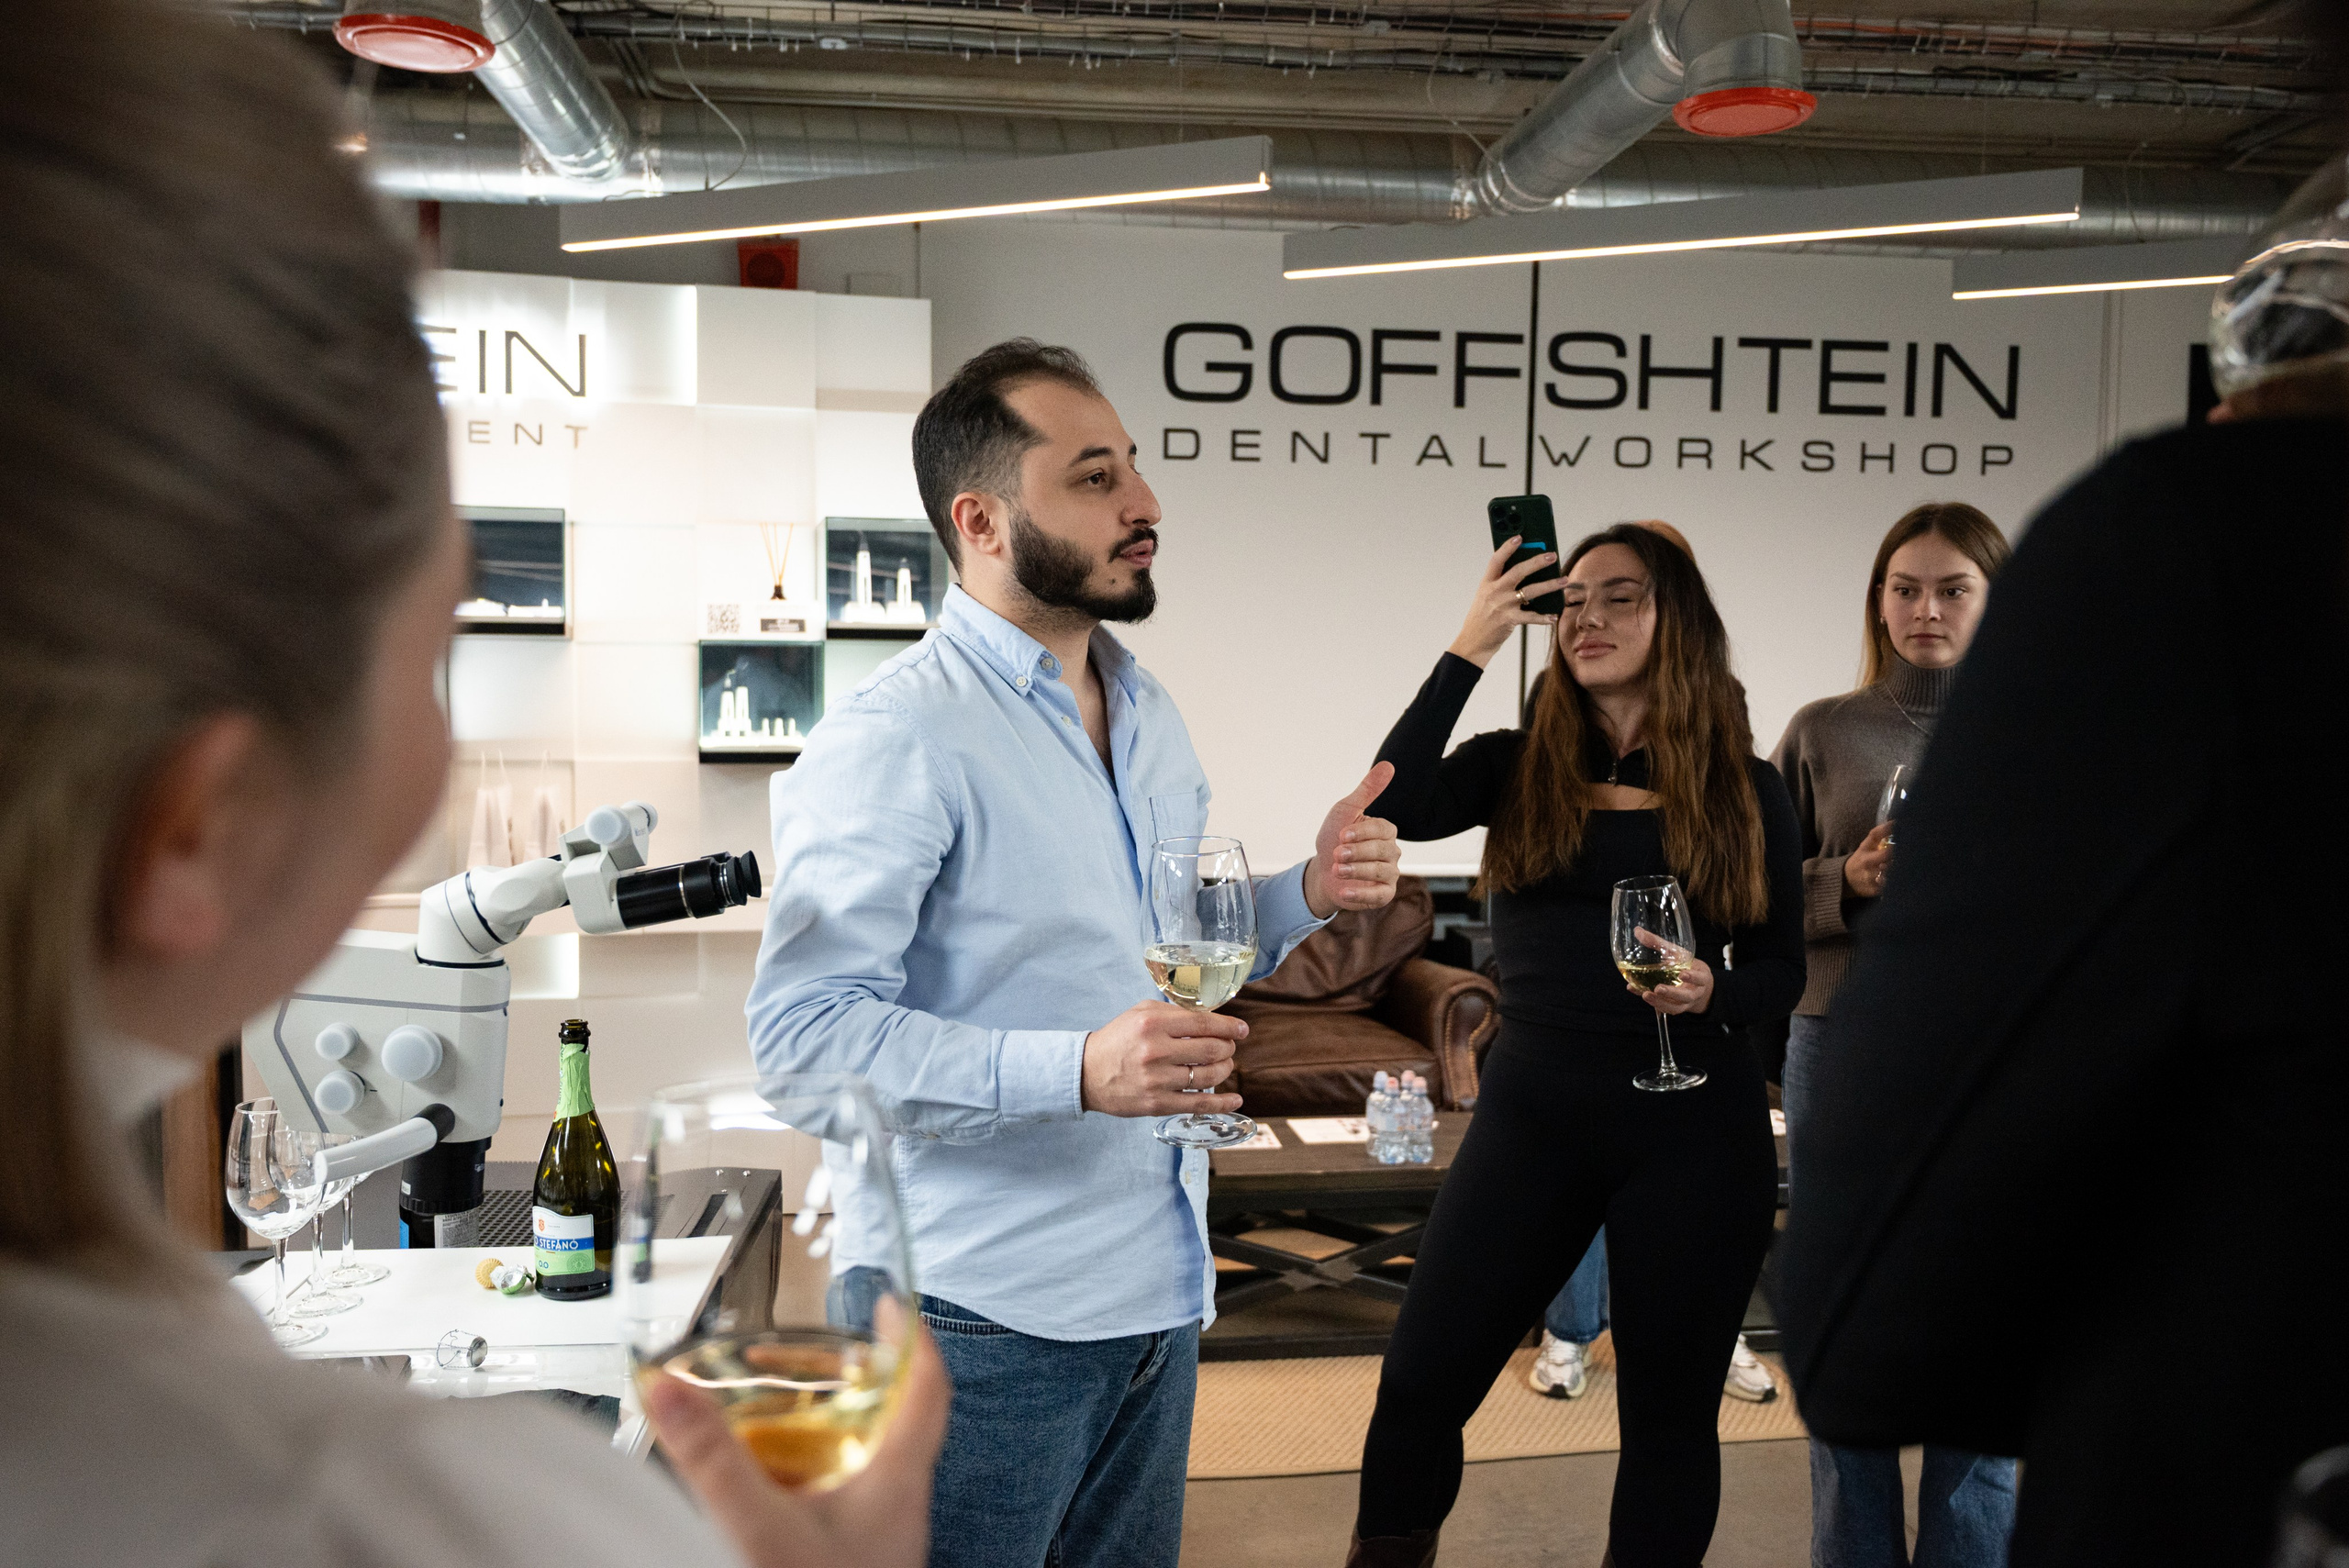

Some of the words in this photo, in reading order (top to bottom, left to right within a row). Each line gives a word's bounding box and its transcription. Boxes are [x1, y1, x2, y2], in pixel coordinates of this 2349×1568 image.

[417, 324, 587, 398] EIN
[1162, 321, 2021, 422] GOFFSHTEIN
[468, 420, 589, 450] ENT
[1163, 428, 1508, 469] DENTAL
[1538, 435, 2015, 476] WORKSHOP
